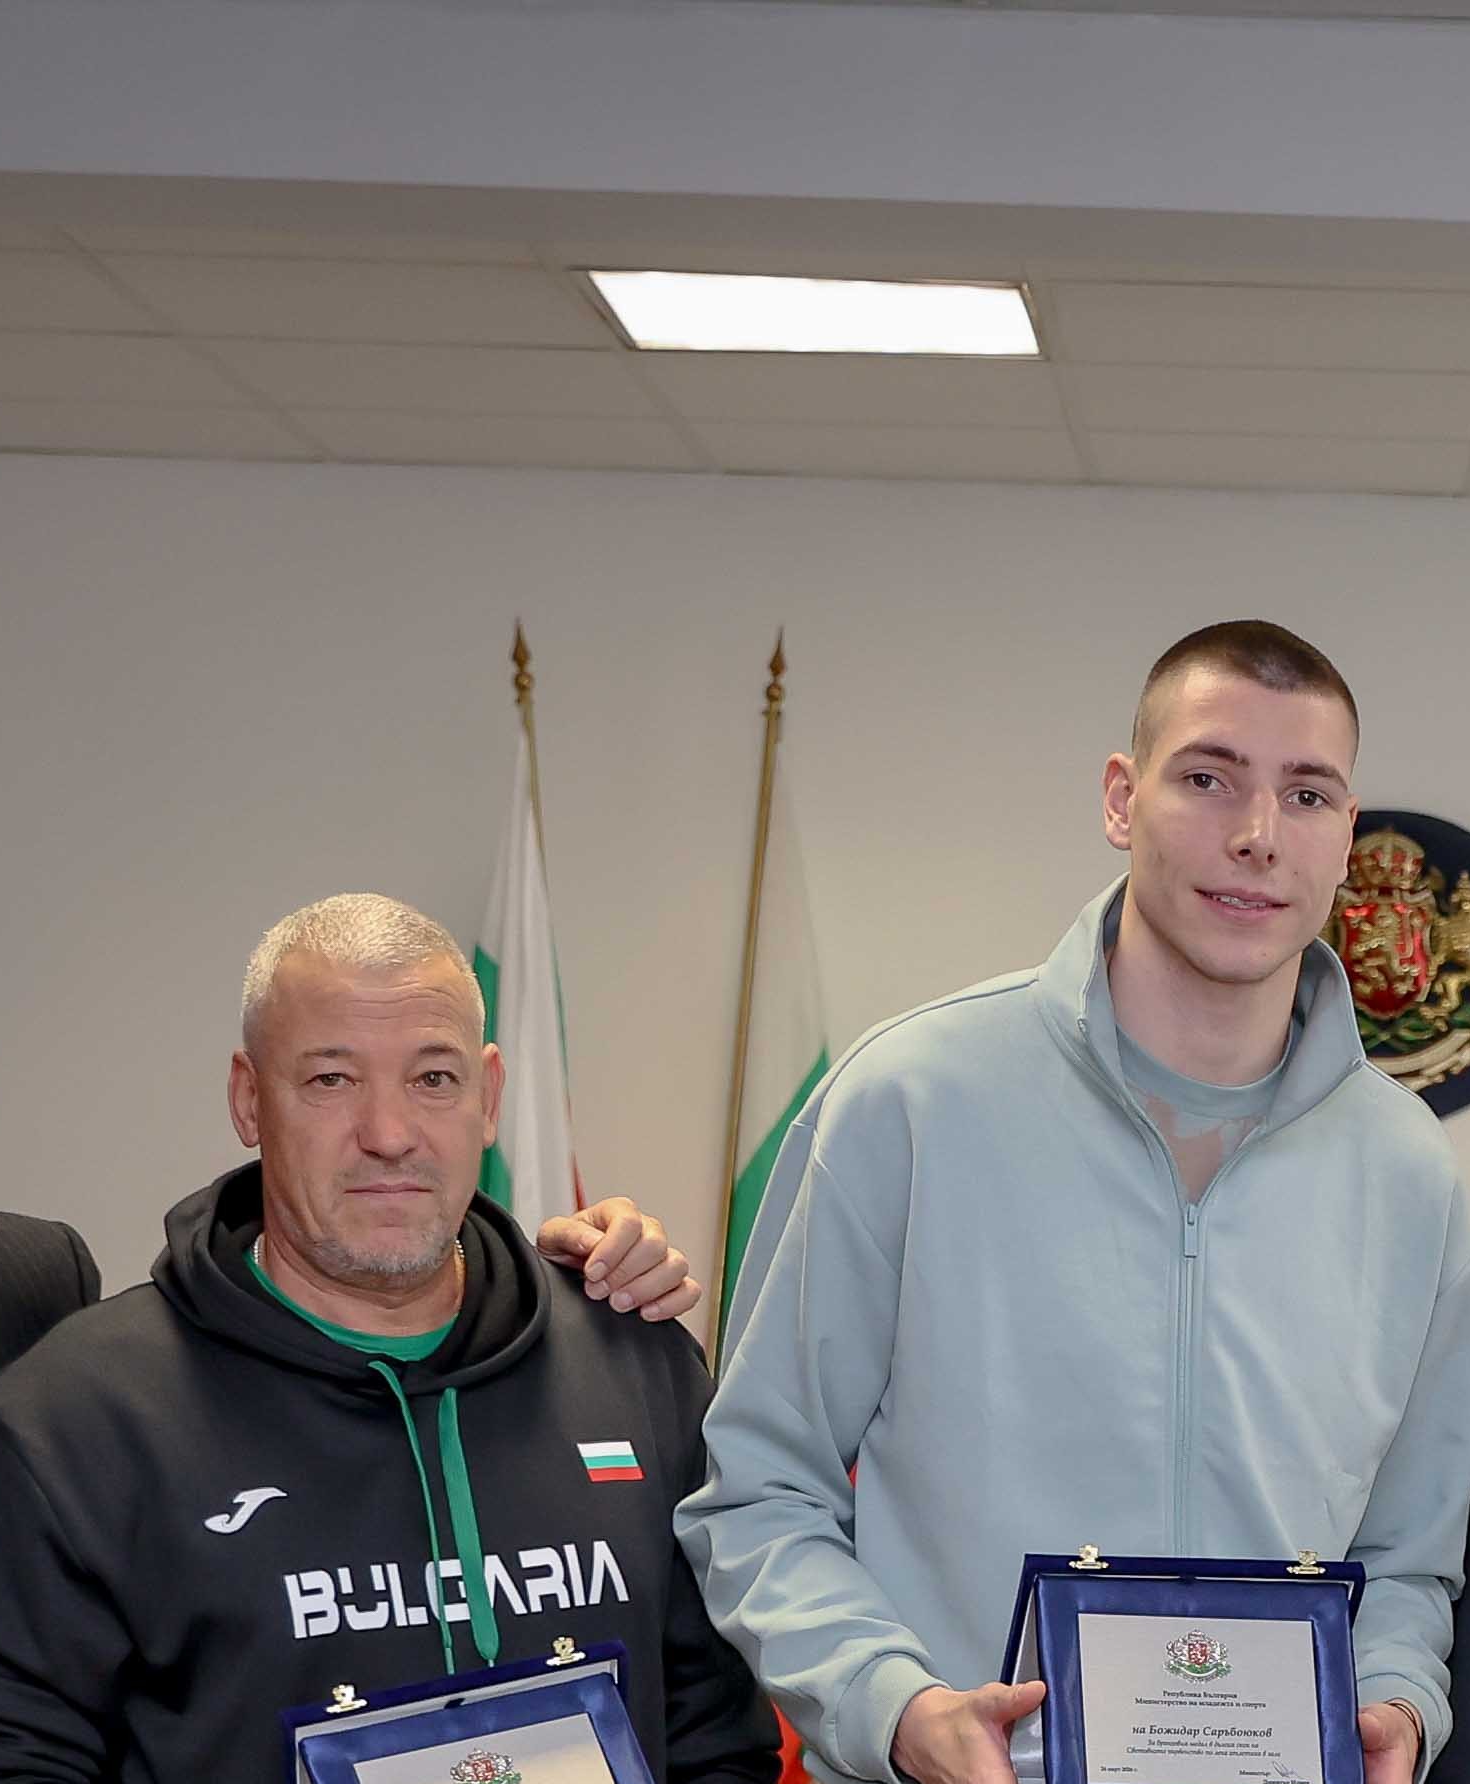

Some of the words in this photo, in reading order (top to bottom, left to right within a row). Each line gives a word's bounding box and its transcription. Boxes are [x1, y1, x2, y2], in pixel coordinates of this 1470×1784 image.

[284, 1540, 630, 1639] BULGARIA
[1162, 1690, 1202, 1698] Република
[1203, 1691, 1237, 1700] България
[1149, 1724, 1200, 1738] Божидар
[1202, 1726, 1272, 1739] Саръбоюков
